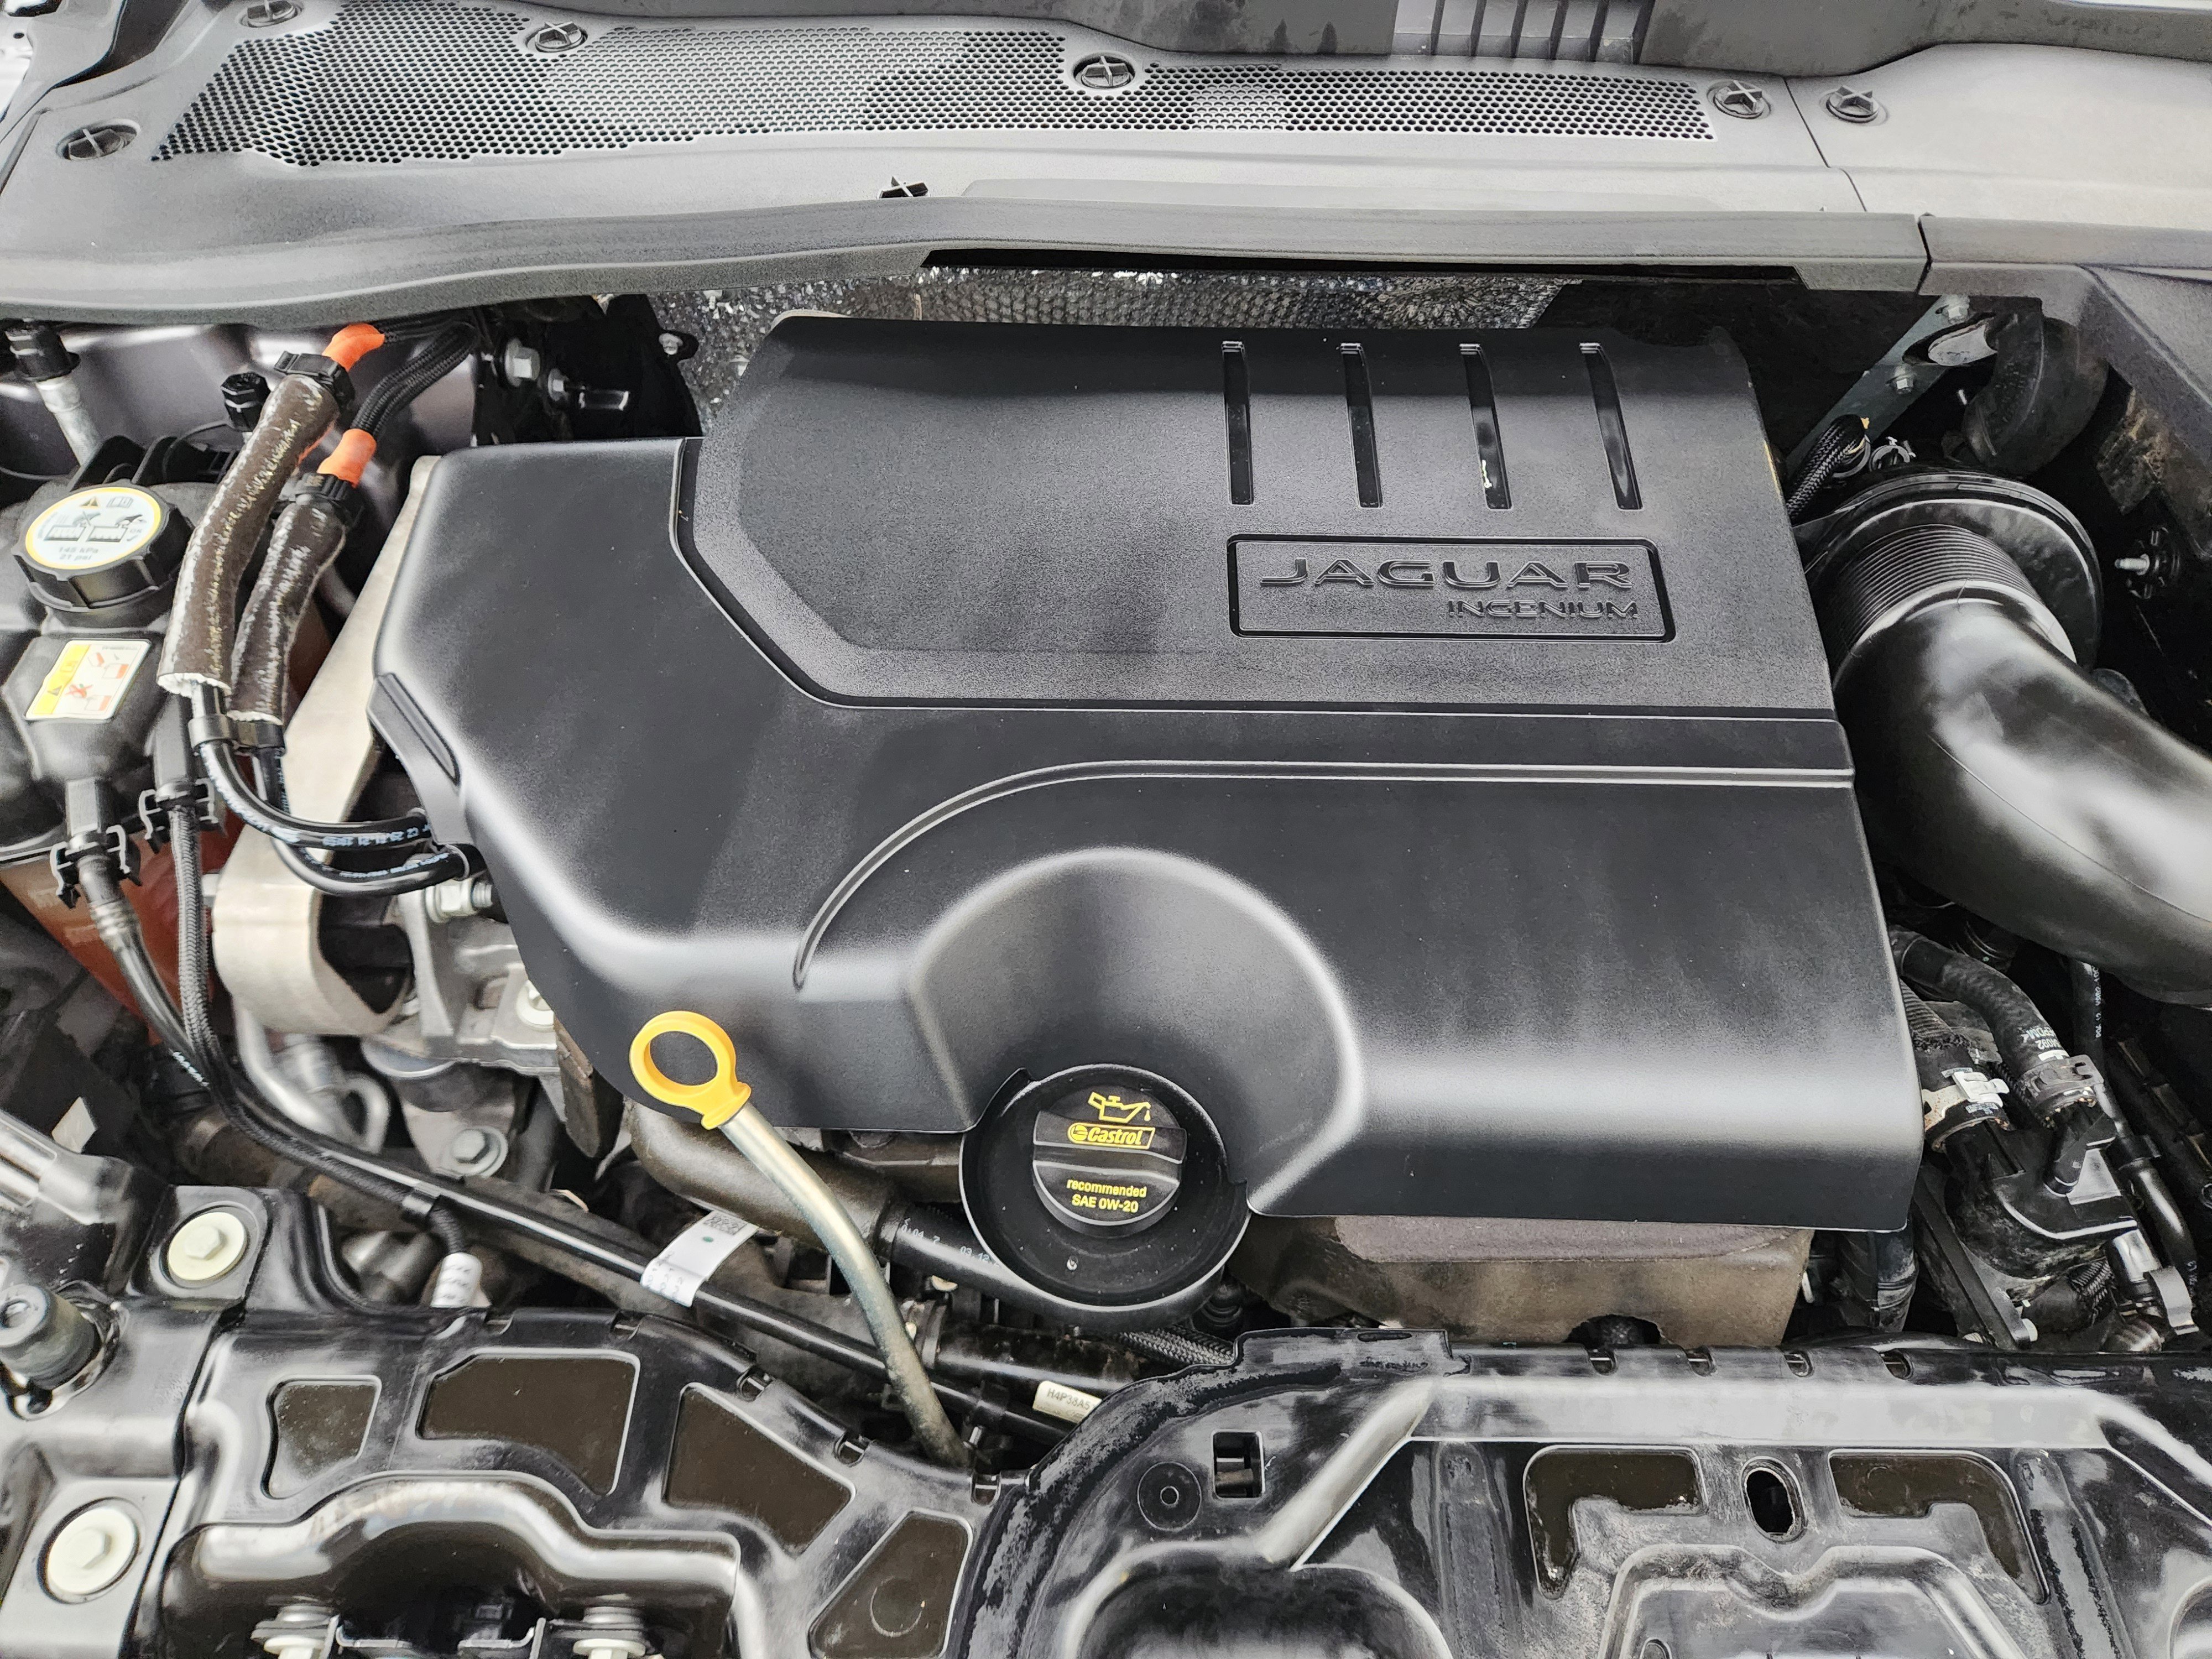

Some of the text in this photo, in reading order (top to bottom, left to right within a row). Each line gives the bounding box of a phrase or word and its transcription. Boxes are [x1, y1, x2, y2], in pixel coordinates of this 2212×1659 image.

[1260, 557, 1632, 589] JAGUAR
[1447, 598, 1639, 619] INGENIUM
[1087, 1126, 1144, 1145] Castrol
[1066, 1178, 1147, 1198] recommended
[1071, 1193, 1139, 1213] SAE 0W-20
